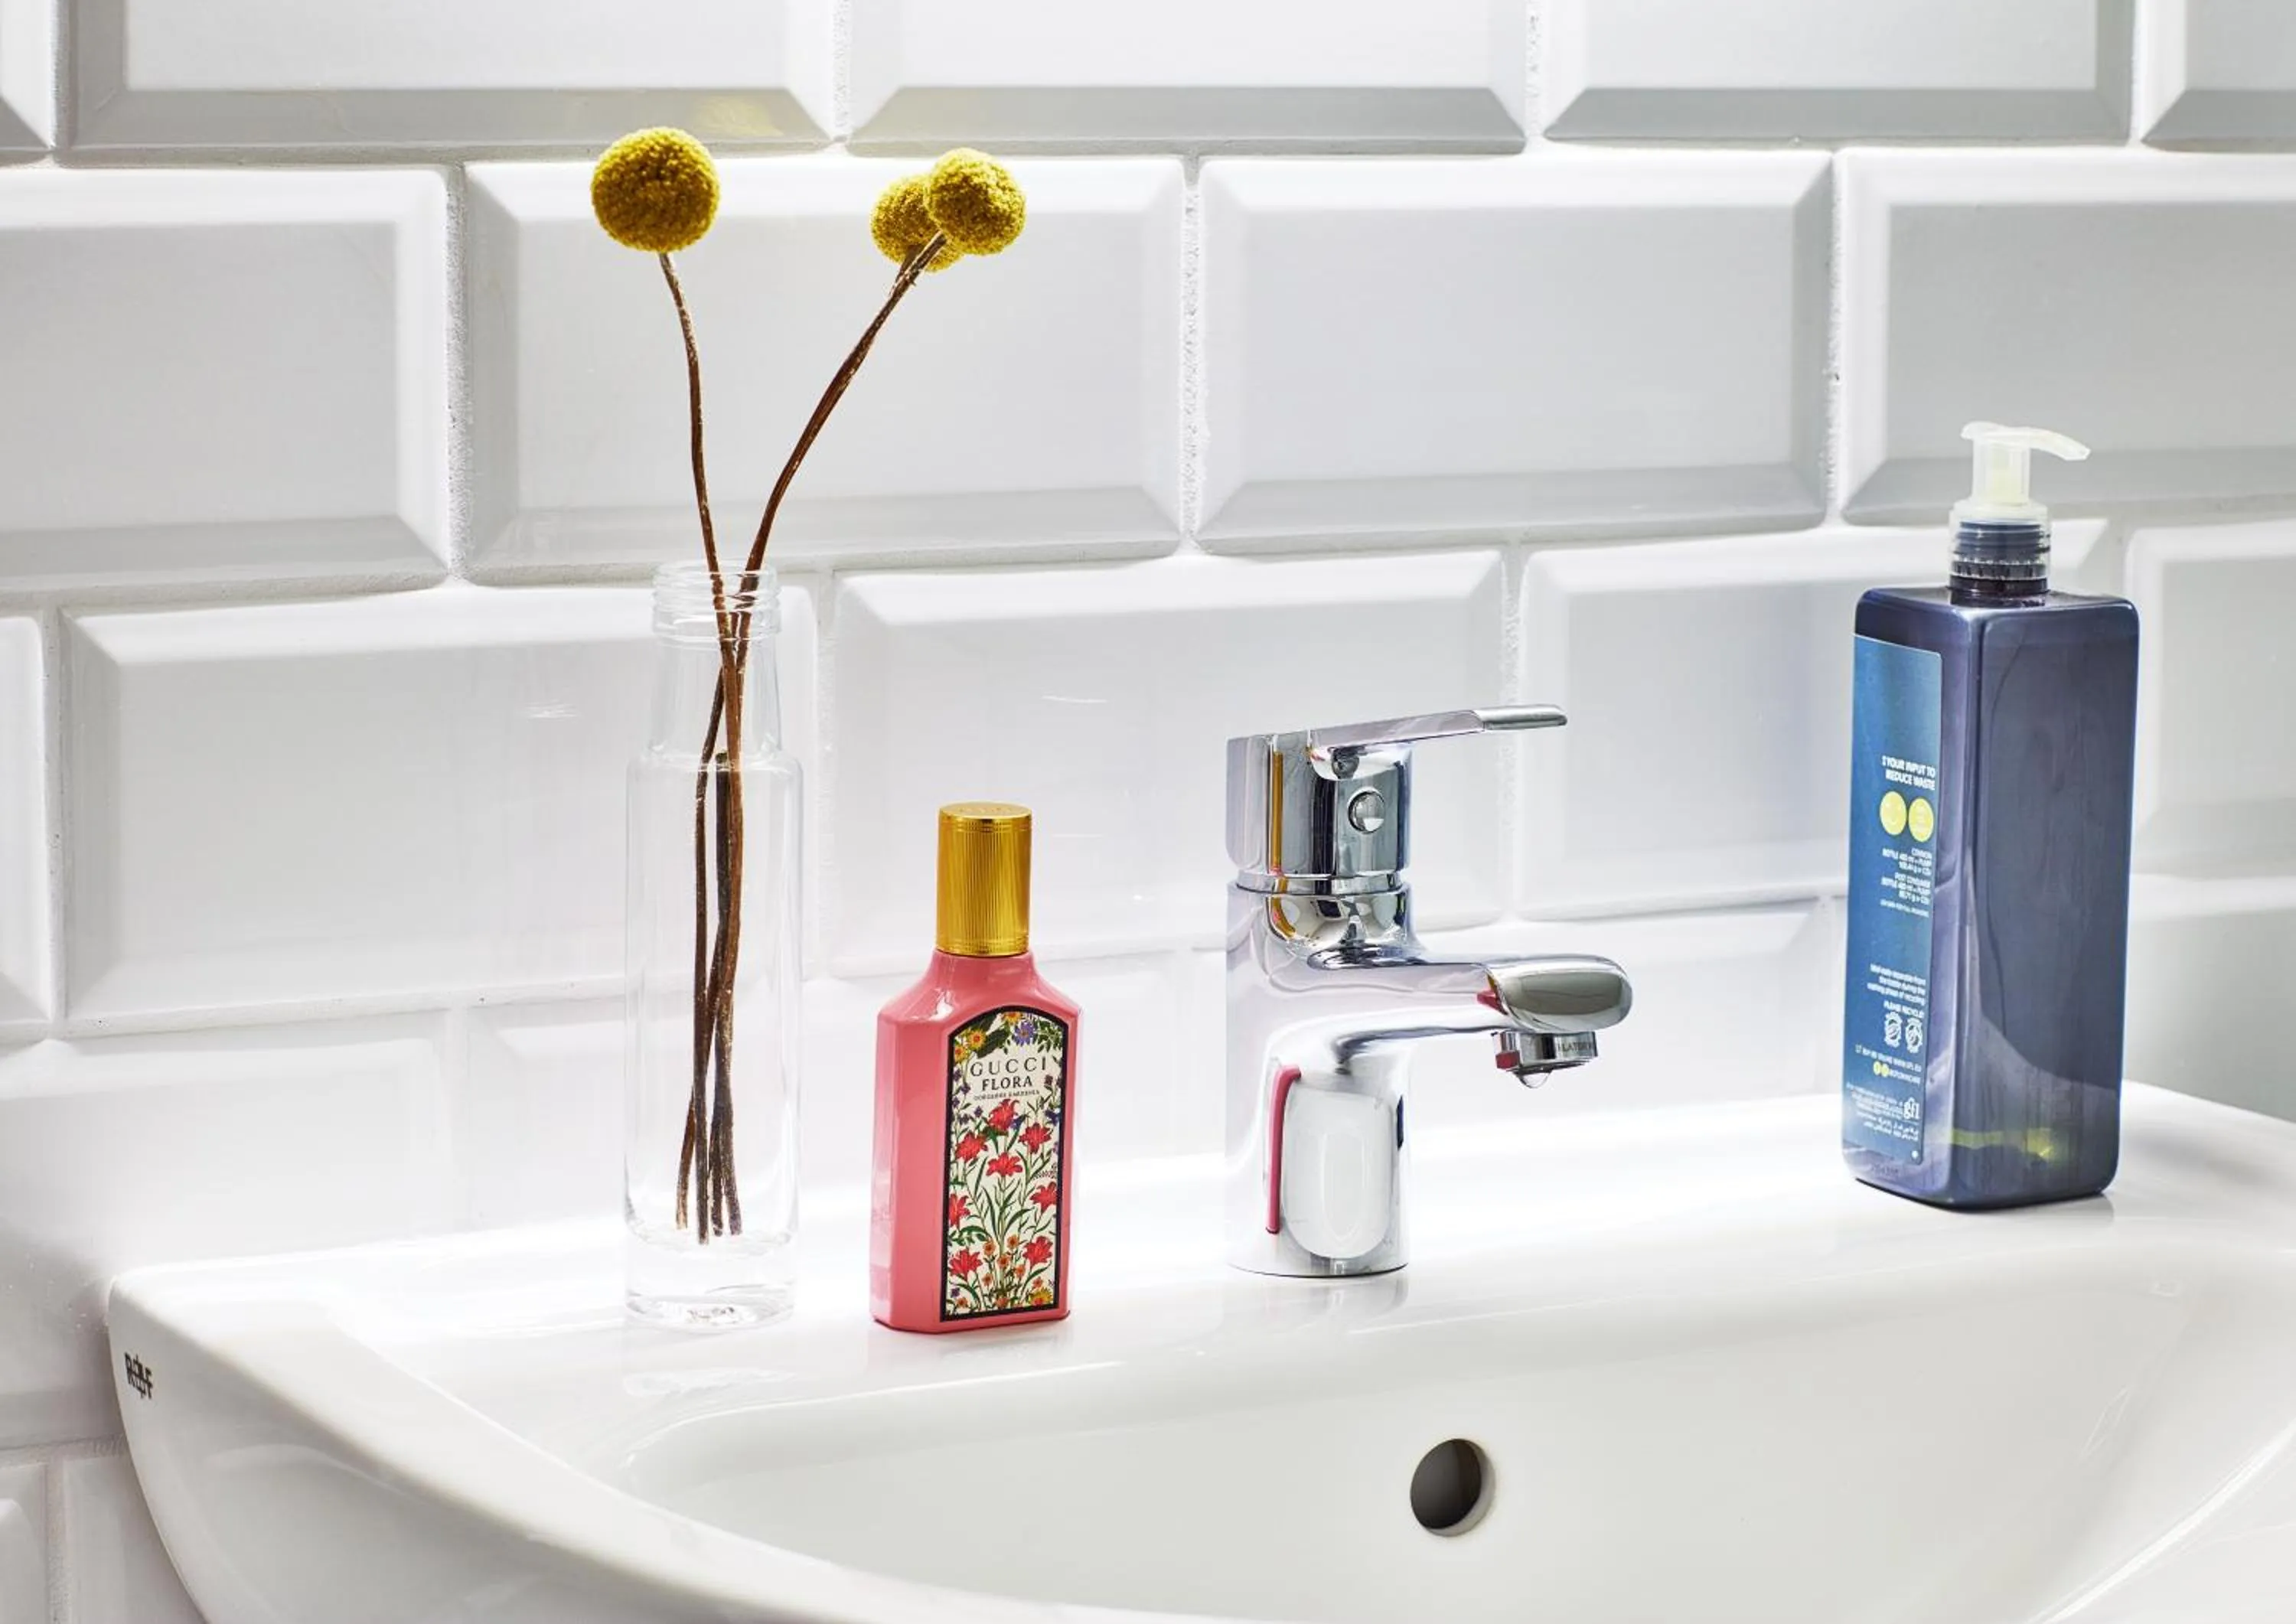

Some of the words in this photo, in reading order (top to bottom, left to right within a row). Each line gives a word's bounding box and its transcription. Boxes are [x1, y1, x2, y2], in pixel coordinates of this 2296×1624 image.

[1926, 765, 1936, 778] TO
[970, 1056, 1046, 1077] GUCCI
[982, 1075, 1033, 1091] FLORA
